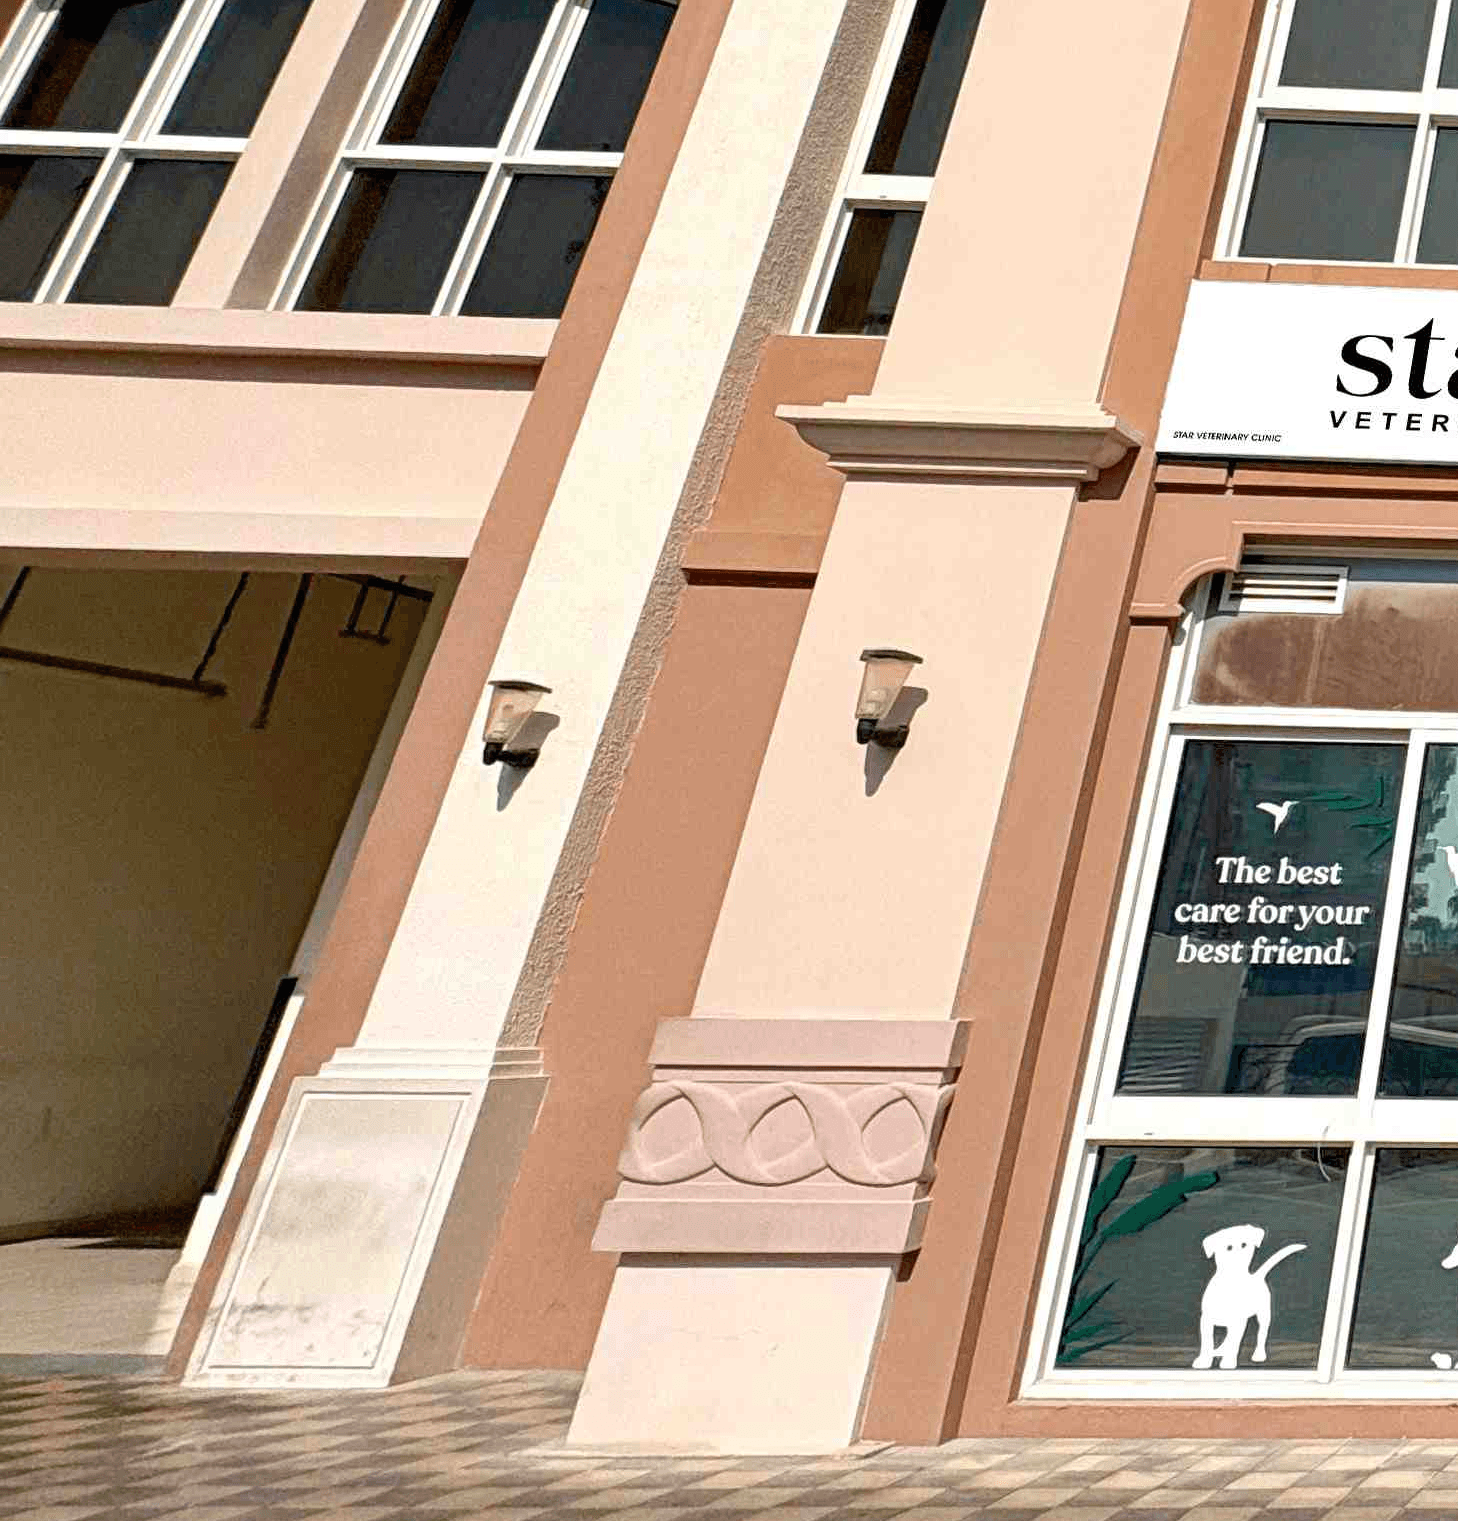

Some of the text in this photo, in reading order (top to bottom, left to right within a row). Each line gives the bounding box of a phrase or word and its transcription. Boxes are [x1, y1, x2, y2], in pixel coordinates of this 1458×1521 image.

[1173, 431, 1282, 442] STAR VETERINARY CLINIC
[1215, 856, 1343, 885] The best
[1174, 896, 1370, 931] care for your
[1176, 935, 1351, 965] best friend.
